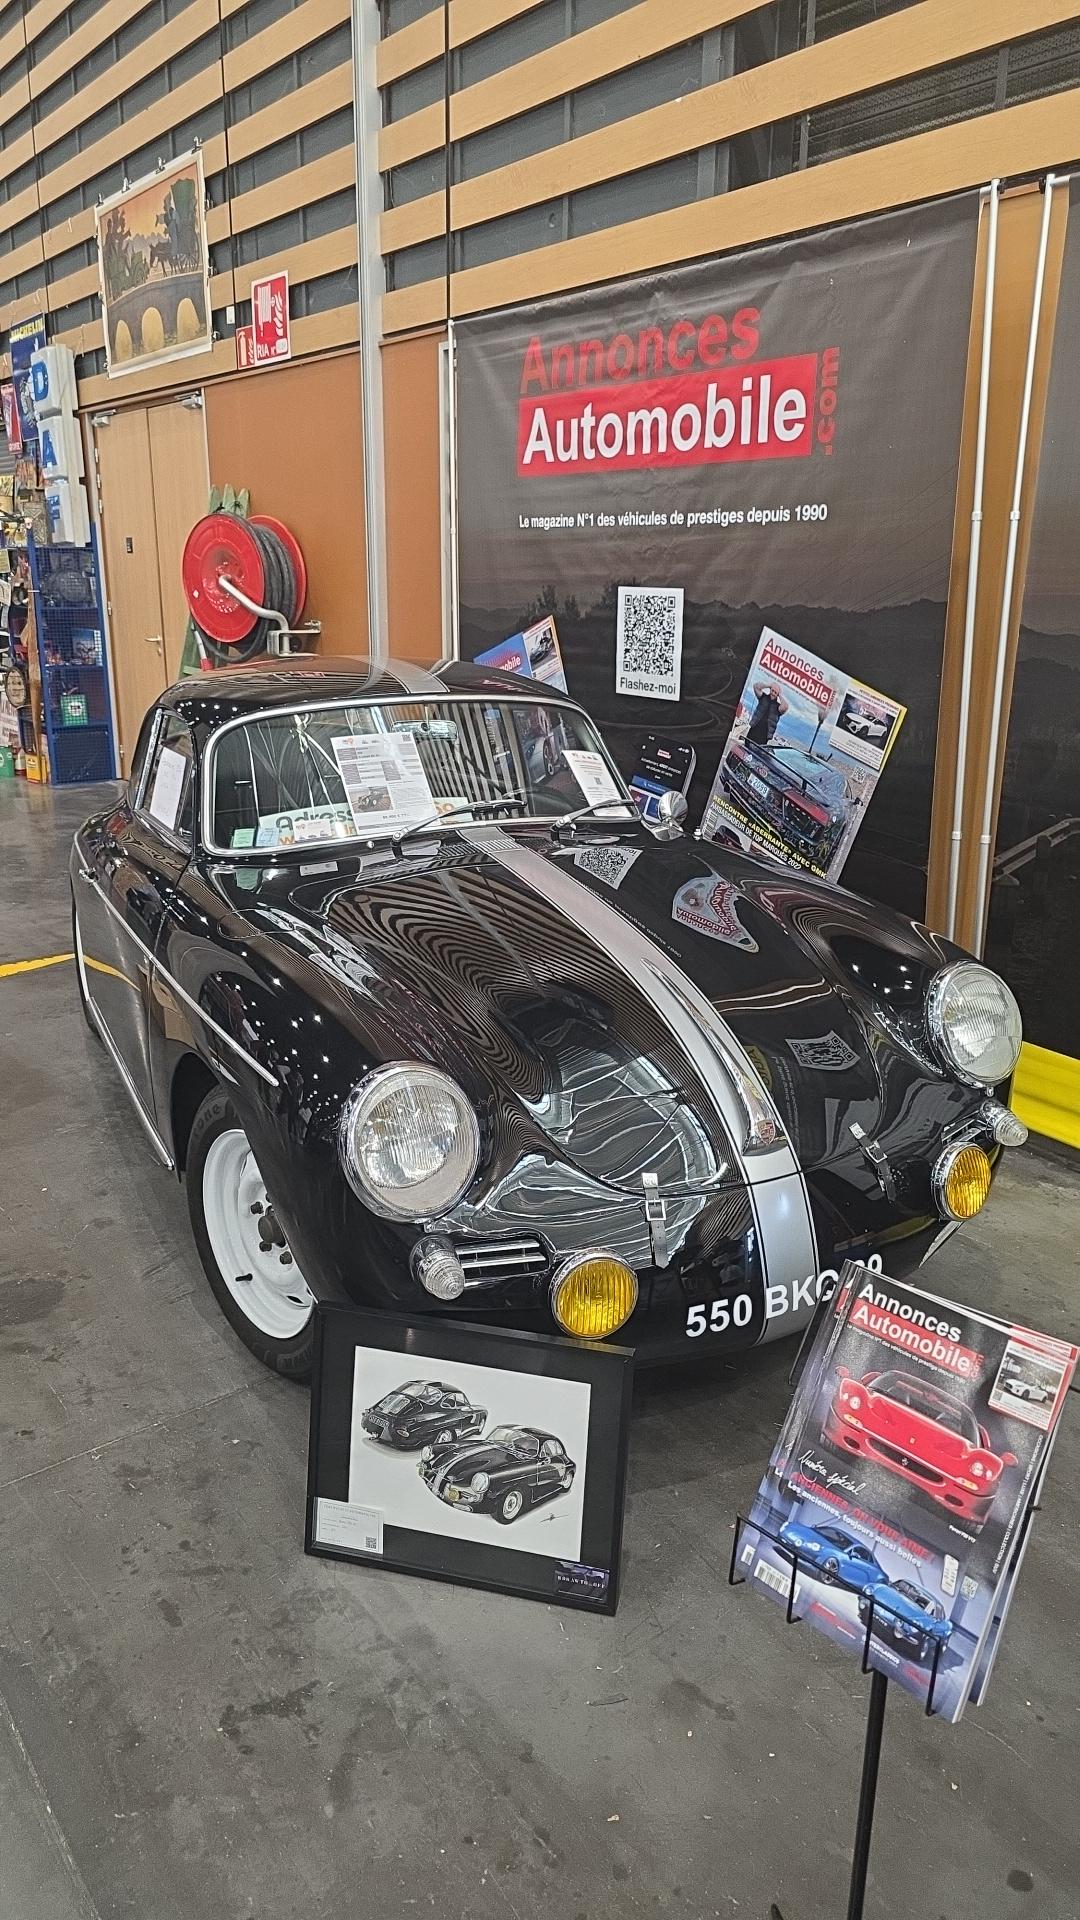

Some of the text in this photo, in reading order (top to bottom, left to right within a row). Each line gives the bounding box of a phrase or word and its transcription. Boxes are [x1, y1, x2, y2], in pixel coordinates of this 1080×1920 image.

[257, 343, 270, 358] RIA
[520, 307, 762, 394] Annonces
[522, 374, 806, 466] Automobile
[817, 346, 841, 456] .com
[519, 504, 827, 530] Le magazine N°1 des véhicules de prestiges depuis 1990
[620, 677, 676, 694] Flashez-moi
[761, 653, 829, 703] Automobile
[765, 638, 824, 681] Annonces
[710, 802, 746, 831] AMBASSADEUR
[746, 827, 753, 836] DE
[752, 831, 763, 842] TOP
[788, 858, 801, 870] 2022
[713, 796, 749, 823] RENCONTRE
[792, 853, 810, 867] AVEC
[811, 866, 828, 879] GMK
[686, 1294, 752, 1337] 550
[853, 1306, 971, 1371] Automobile
[857, 1283, 962, 1342] Annonces
[787, 1480, 922, 1568] Les anciennes, toujours aussi belles
